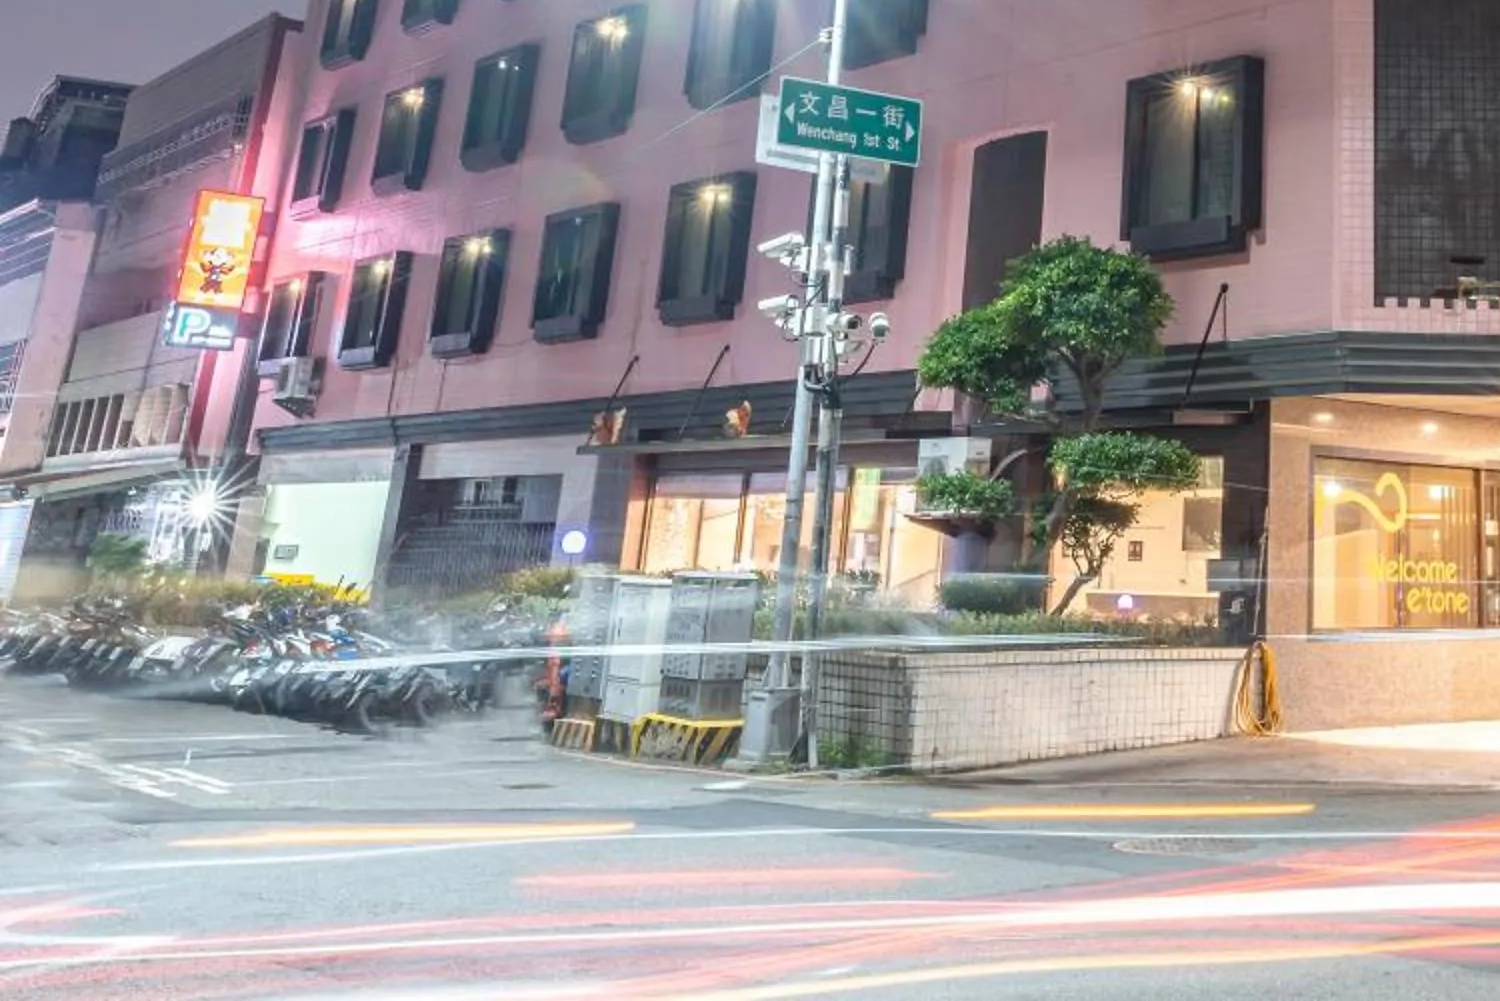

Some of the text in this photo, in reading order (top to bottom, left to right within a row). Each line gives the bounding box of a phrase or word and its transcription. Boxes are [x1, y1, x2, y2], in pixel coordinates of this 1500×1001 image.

[800, 91, 905, 129] 文昌一街
[797, 121, 857, 149] Wenchang
[887, 136, 900, 151] St
[1407, 587, 1469, 614] e'tone
